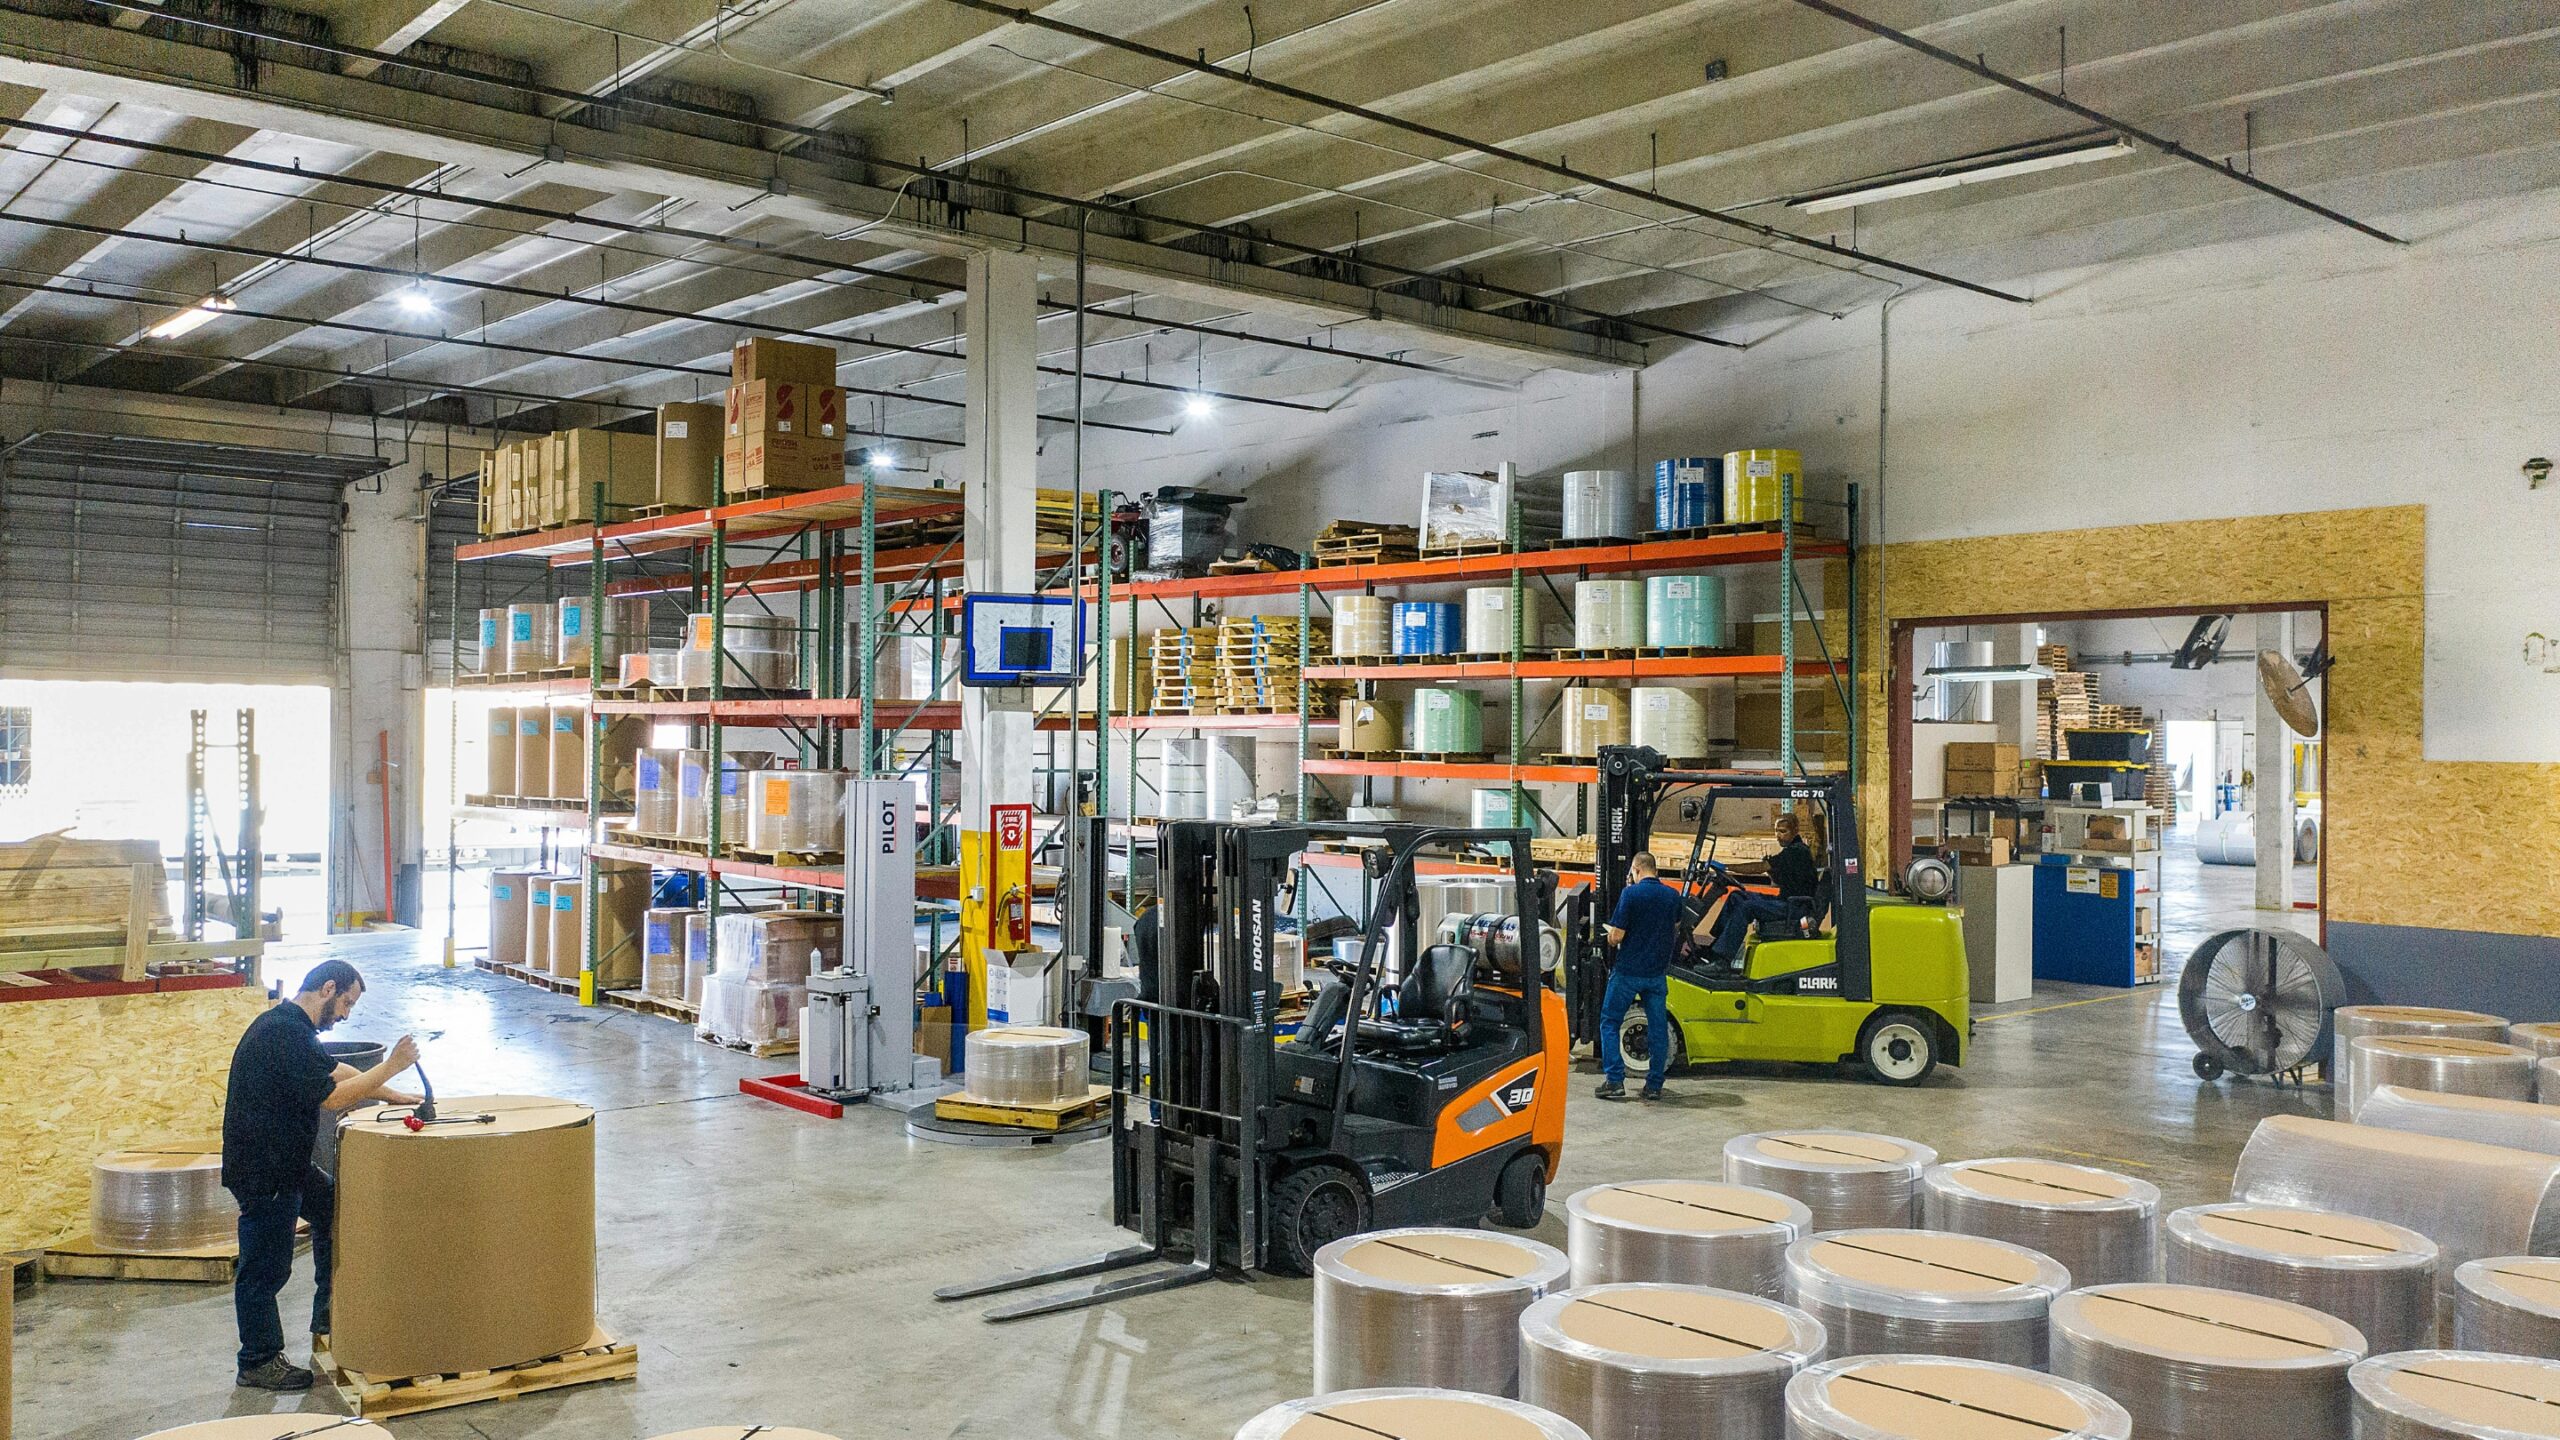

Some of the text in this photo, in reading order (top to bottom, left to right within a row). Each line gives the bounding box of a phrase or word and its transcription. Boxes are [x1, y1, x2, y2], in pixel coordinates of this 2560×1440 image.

[1791, 790, 1825, 798] CGC 70
[882, 800, 895, 854] PILOT
[1611, 807, 1623, 844] CLARK
[1252, 899, 1263, 972] DOOSAN
[1798, 977, 1838, 989] CLARK
[1508, 1087, 1535, 1107] 30
